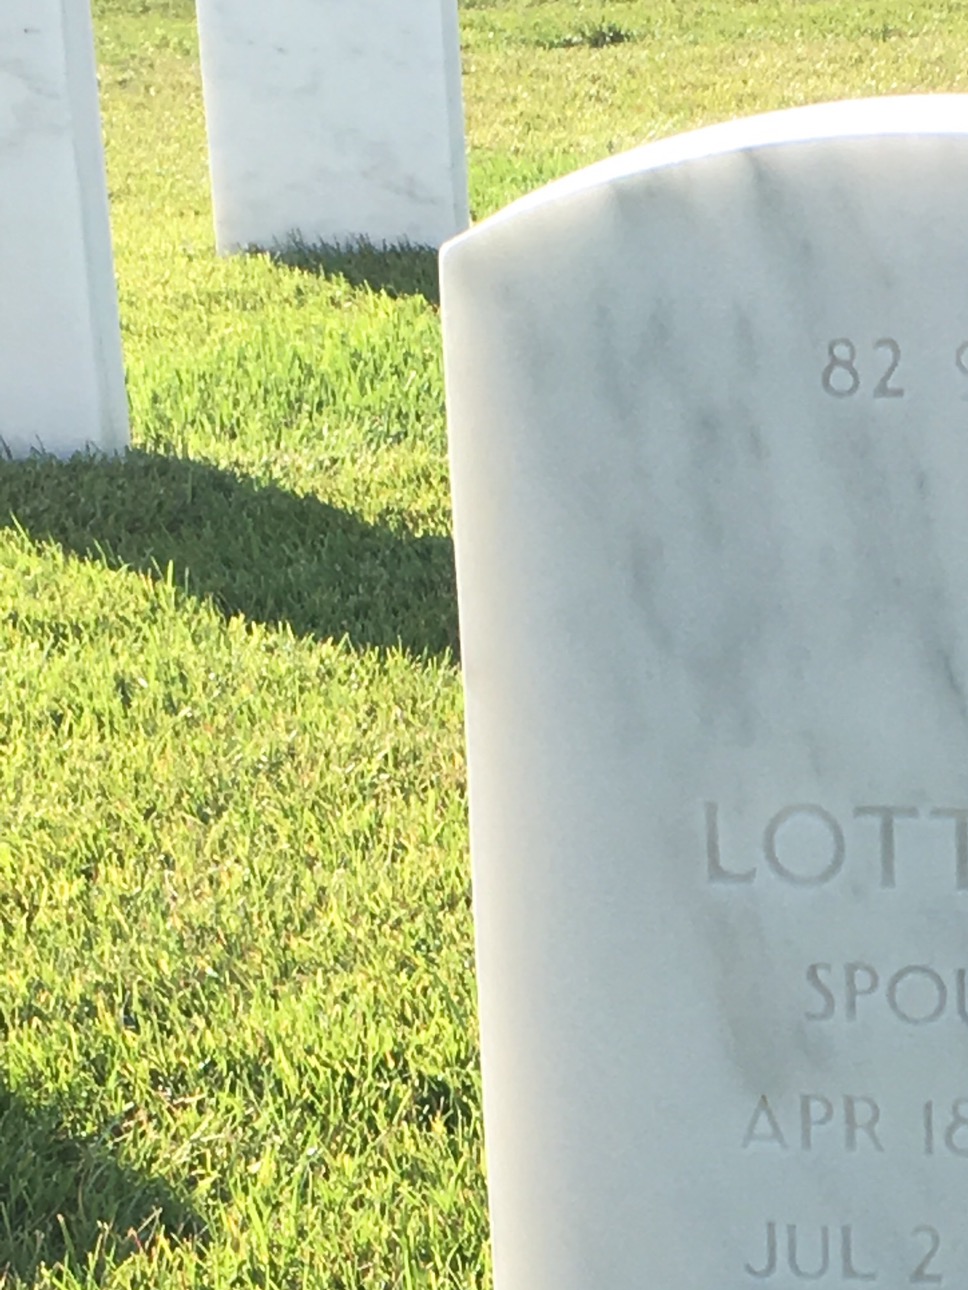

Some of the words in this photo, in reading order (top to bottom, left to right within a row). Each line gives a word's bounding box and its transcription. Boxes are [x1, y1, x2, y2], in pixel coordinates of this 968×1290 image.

[821, 337, 905, 400] 82
[742, 1092, 885, 1154] APR
[743, 1219, 877, 1280] JUL
[908, 1224, 944, 1285] 2
